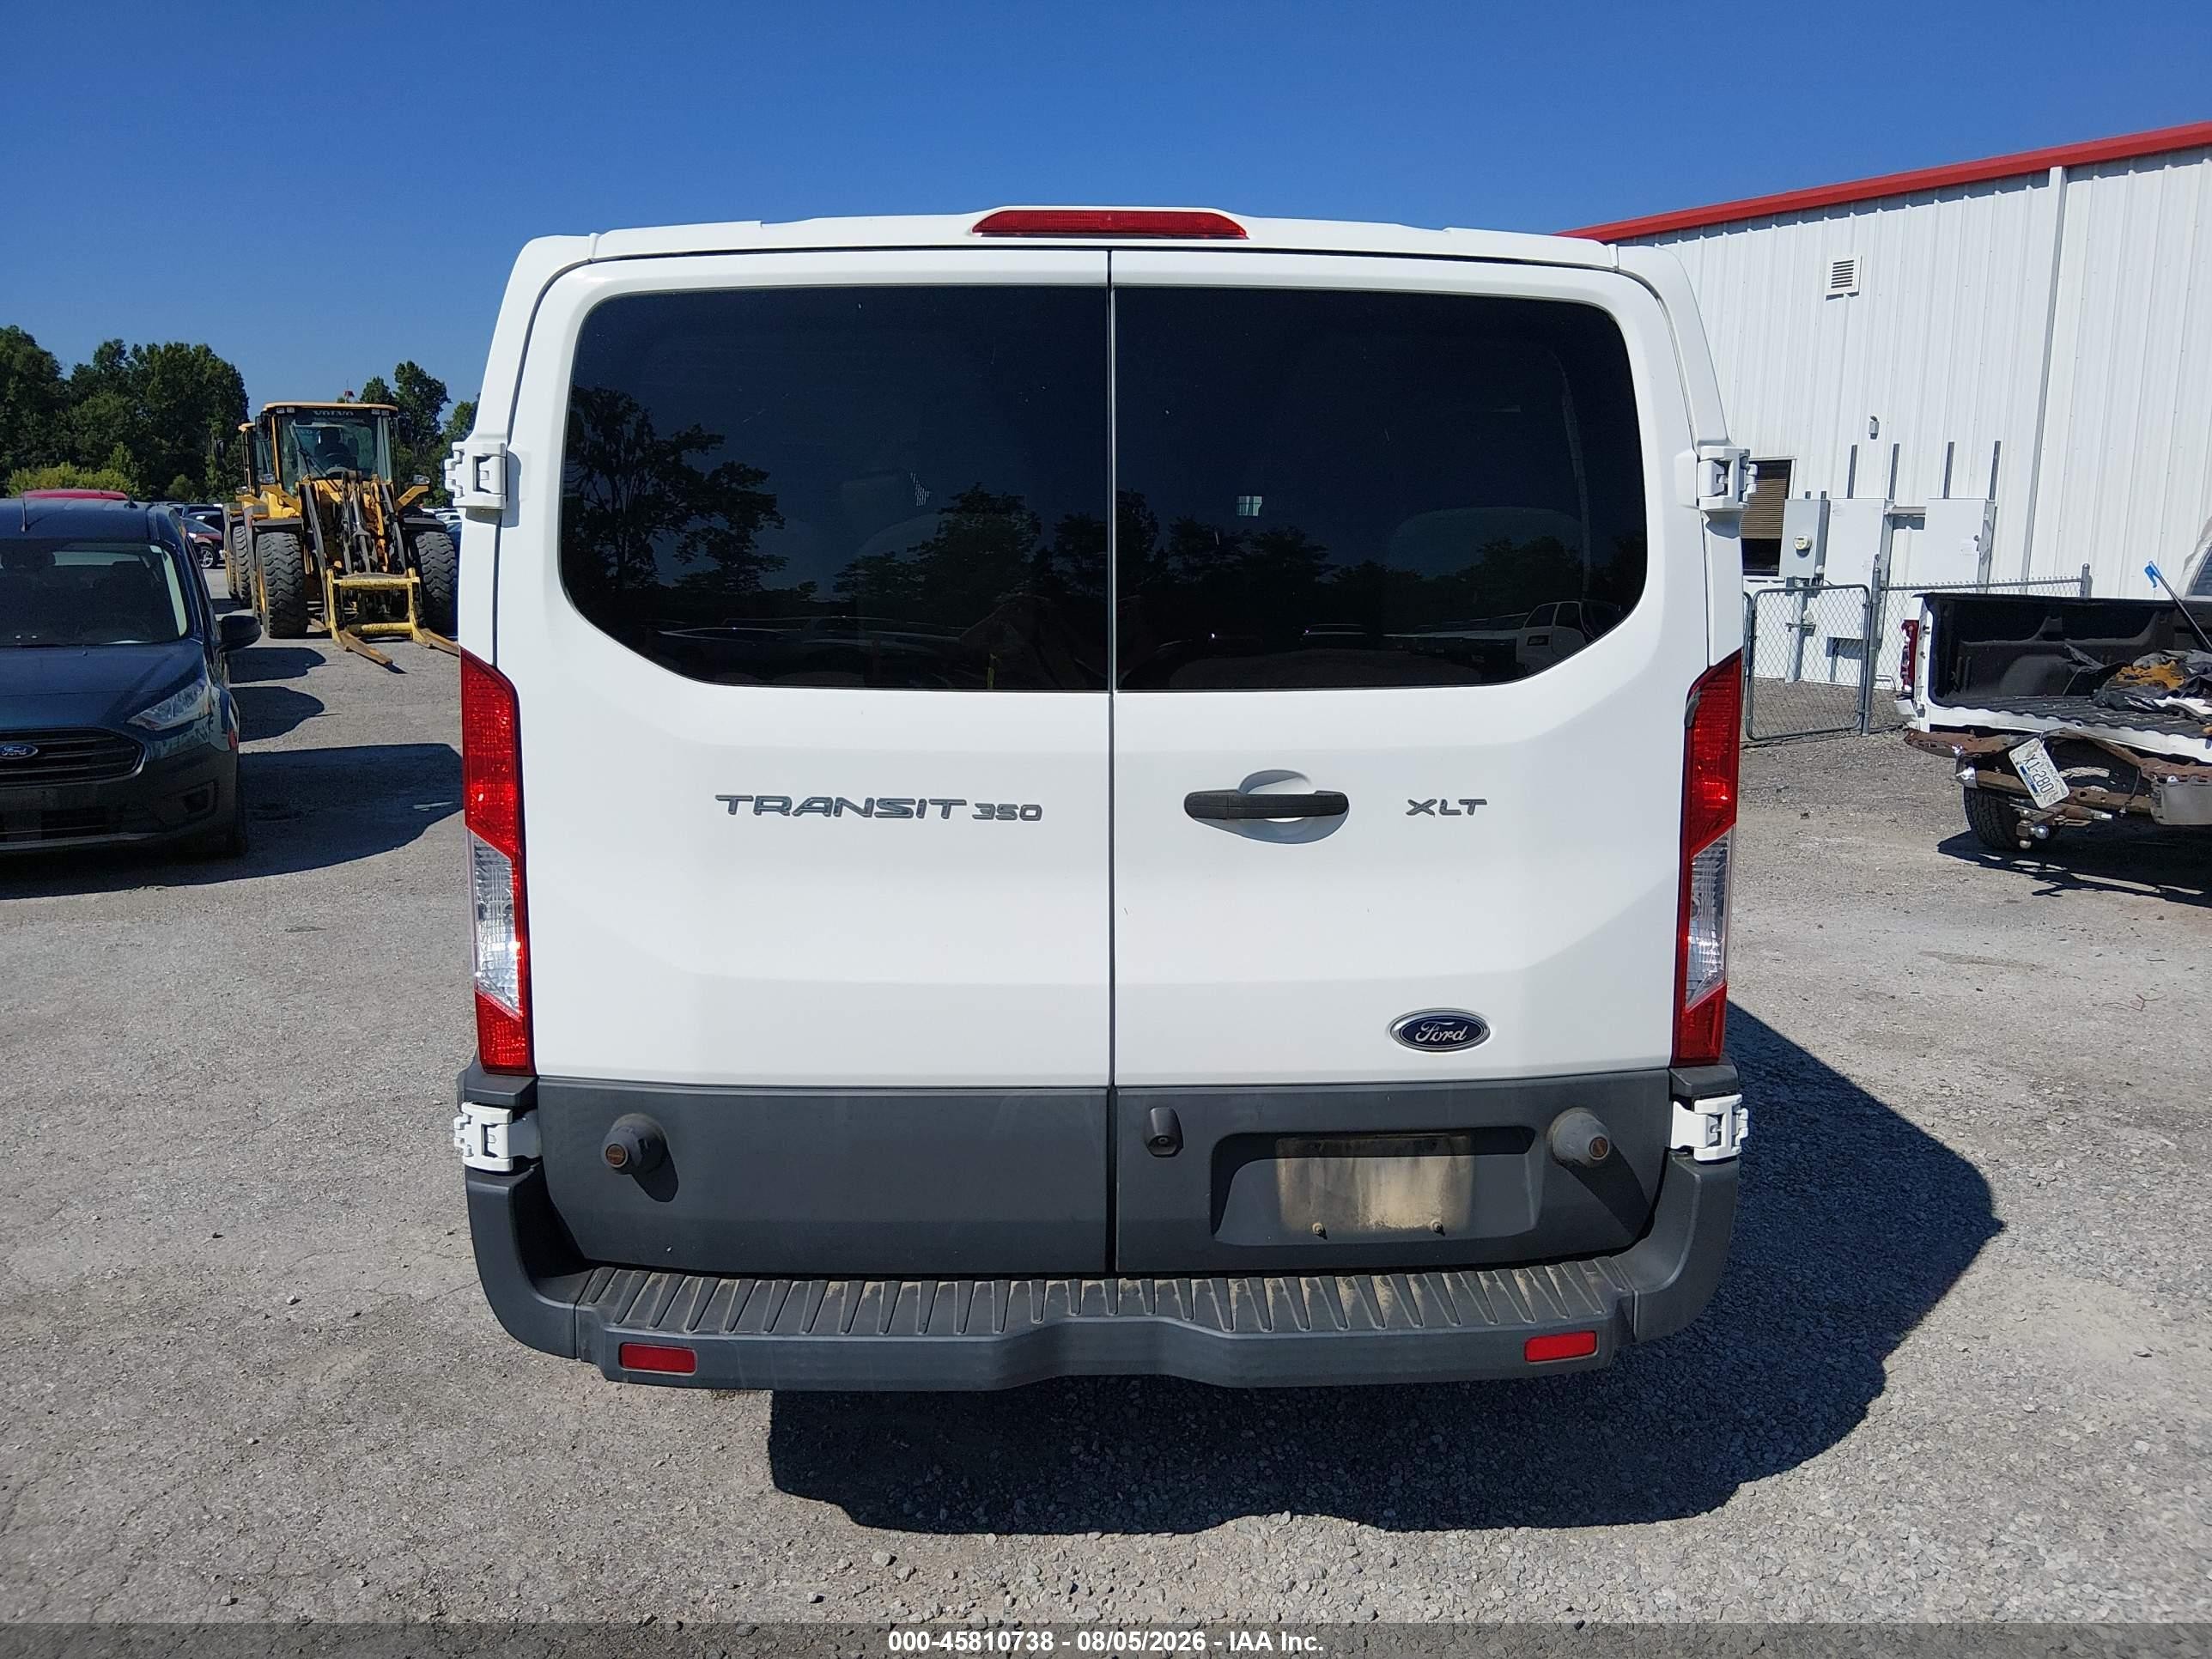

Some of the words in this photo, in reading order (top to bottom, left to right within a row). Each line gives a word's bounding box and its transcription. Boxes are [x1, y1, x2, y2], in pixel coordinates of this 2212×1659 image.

[2, 746, 27, 756] Ford
[2023, 753, 2055, 793] X1-280
[714, 794, 967, 820] TRANSIT
[972, 802, 1042, 822] 350
[1405, 798, 1488, 817] XLT
[1414, 1020, 1468, 1042] Ford
